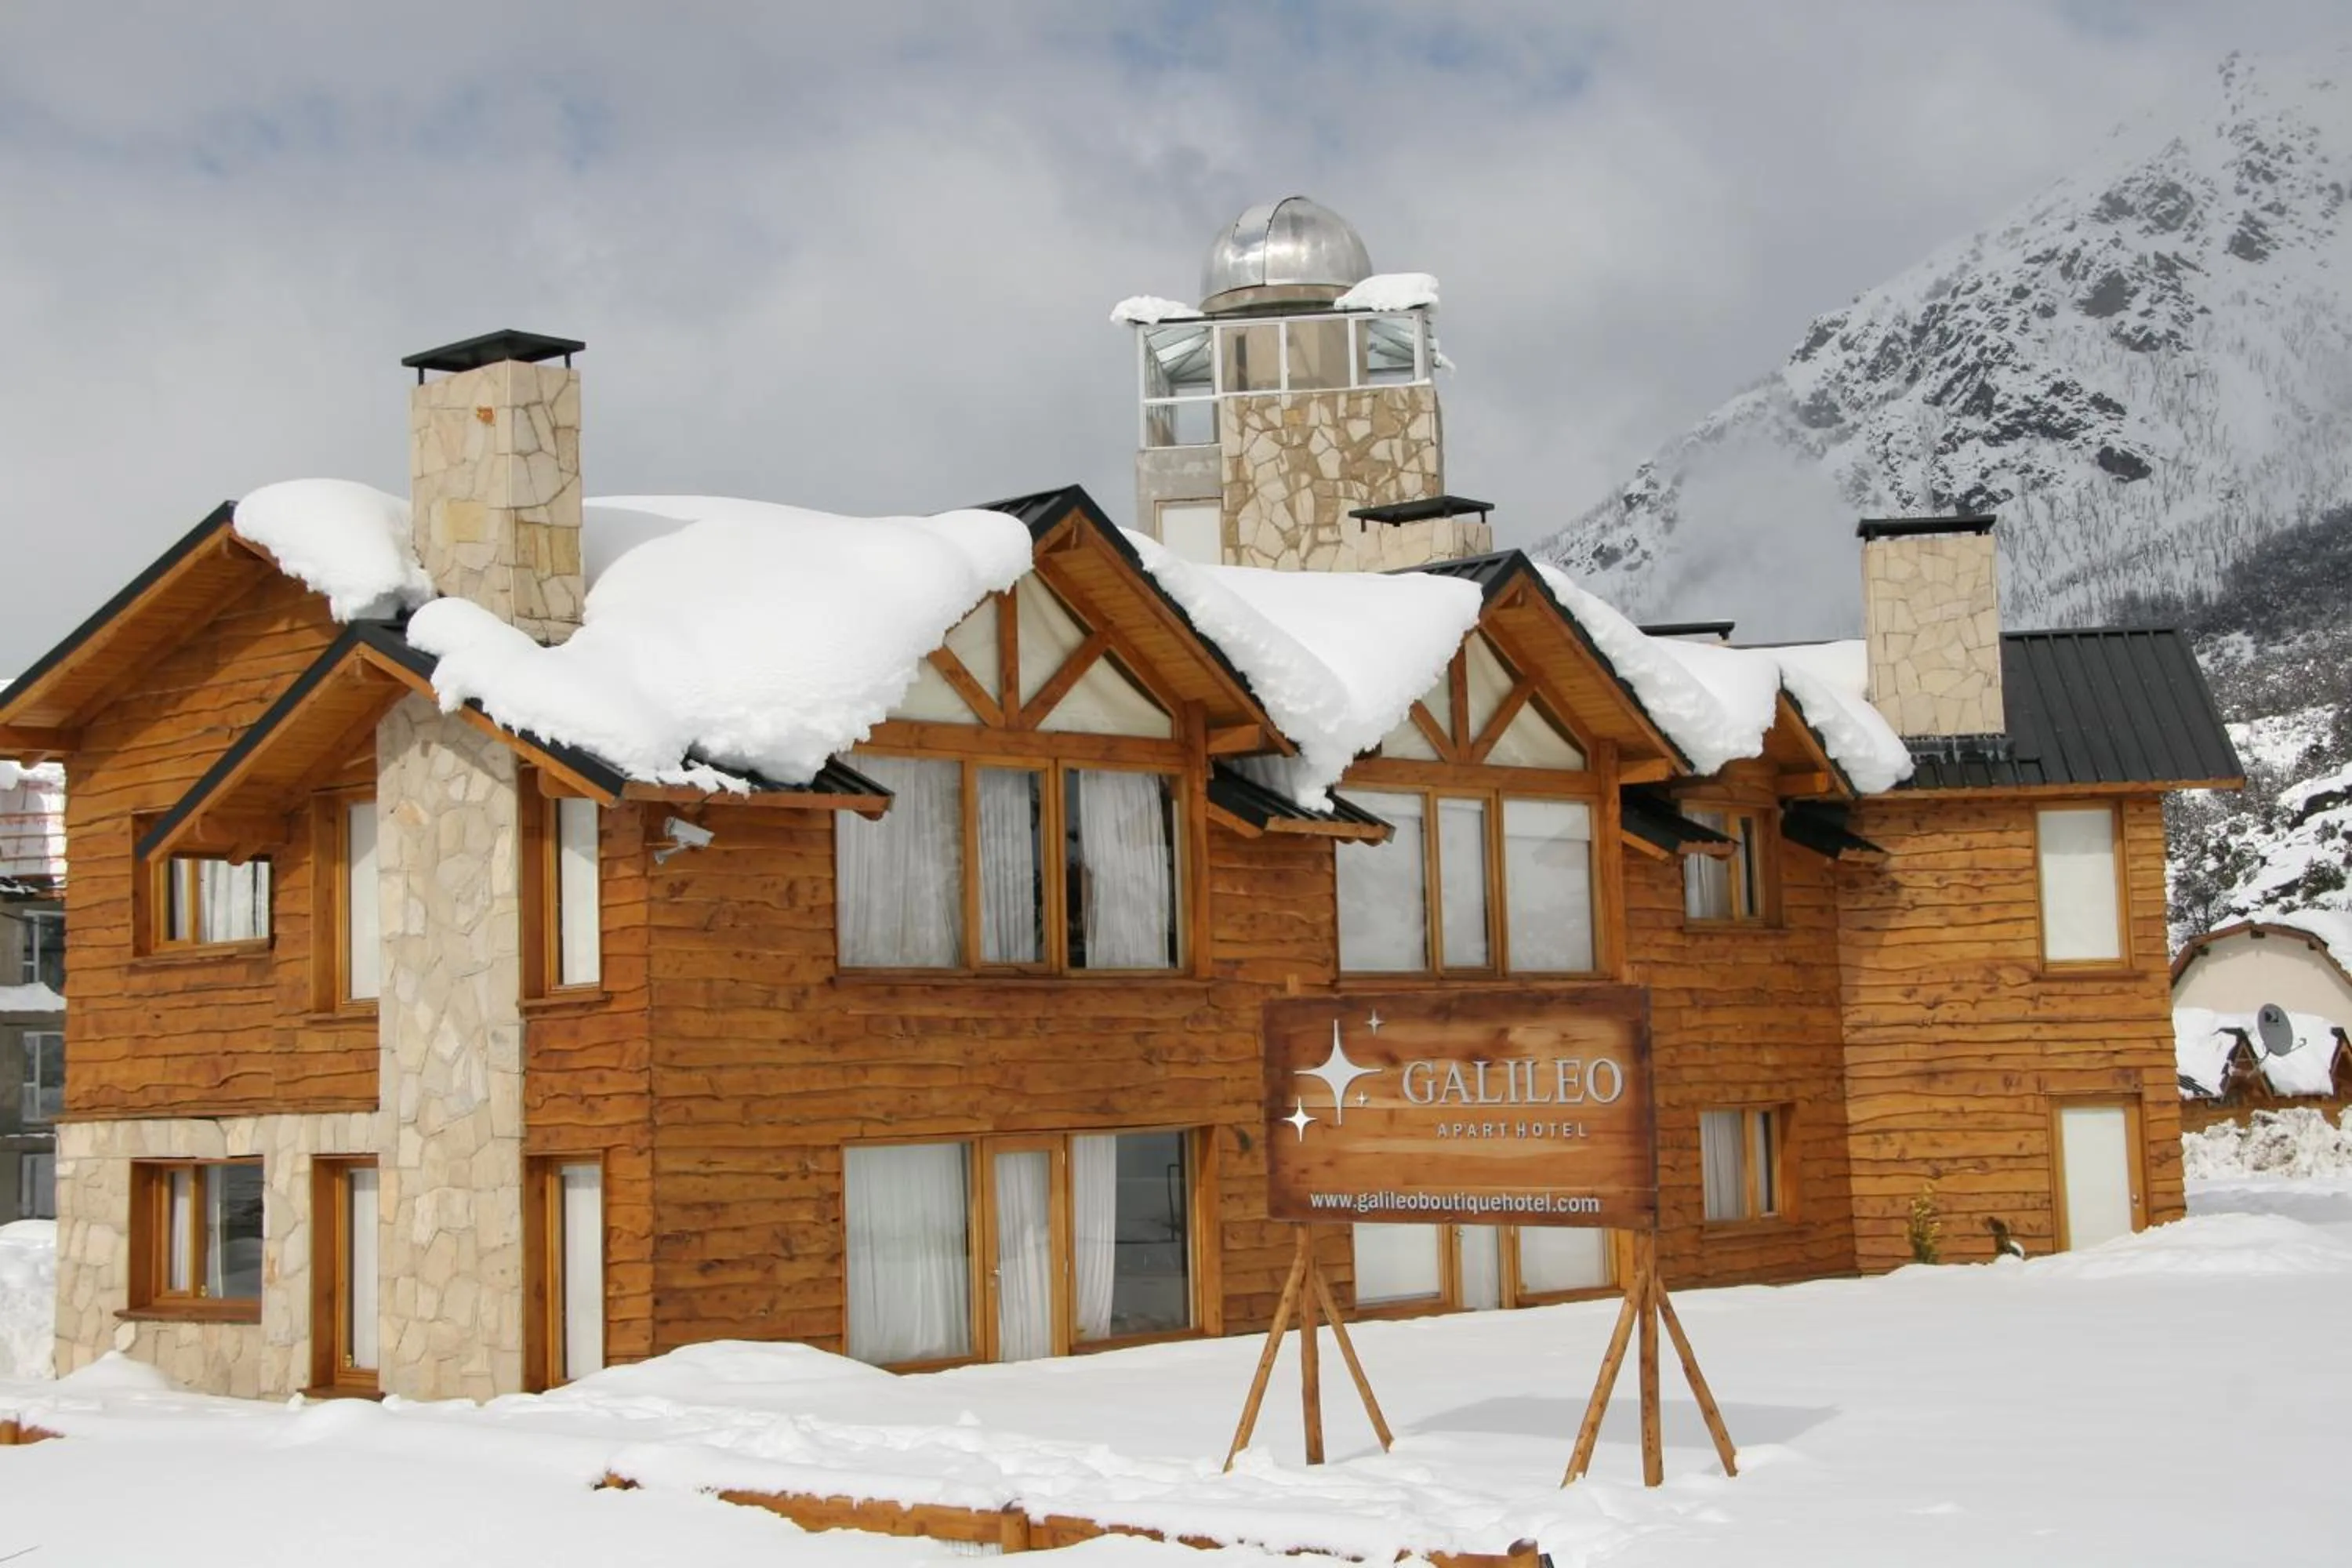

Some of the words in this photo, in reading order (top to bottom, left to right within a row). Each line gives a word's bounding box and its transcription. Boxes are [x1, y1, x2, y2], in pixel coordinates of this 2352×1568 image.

[1402, 1058, 1624, 1104] GALILEO
[1438, 1122, 1507, 1137] APART
[1517, 1122, 1588, 1137] HOTEL
[1310, 1191, 1600, 1214] www.galileoboutiquehotel.com
